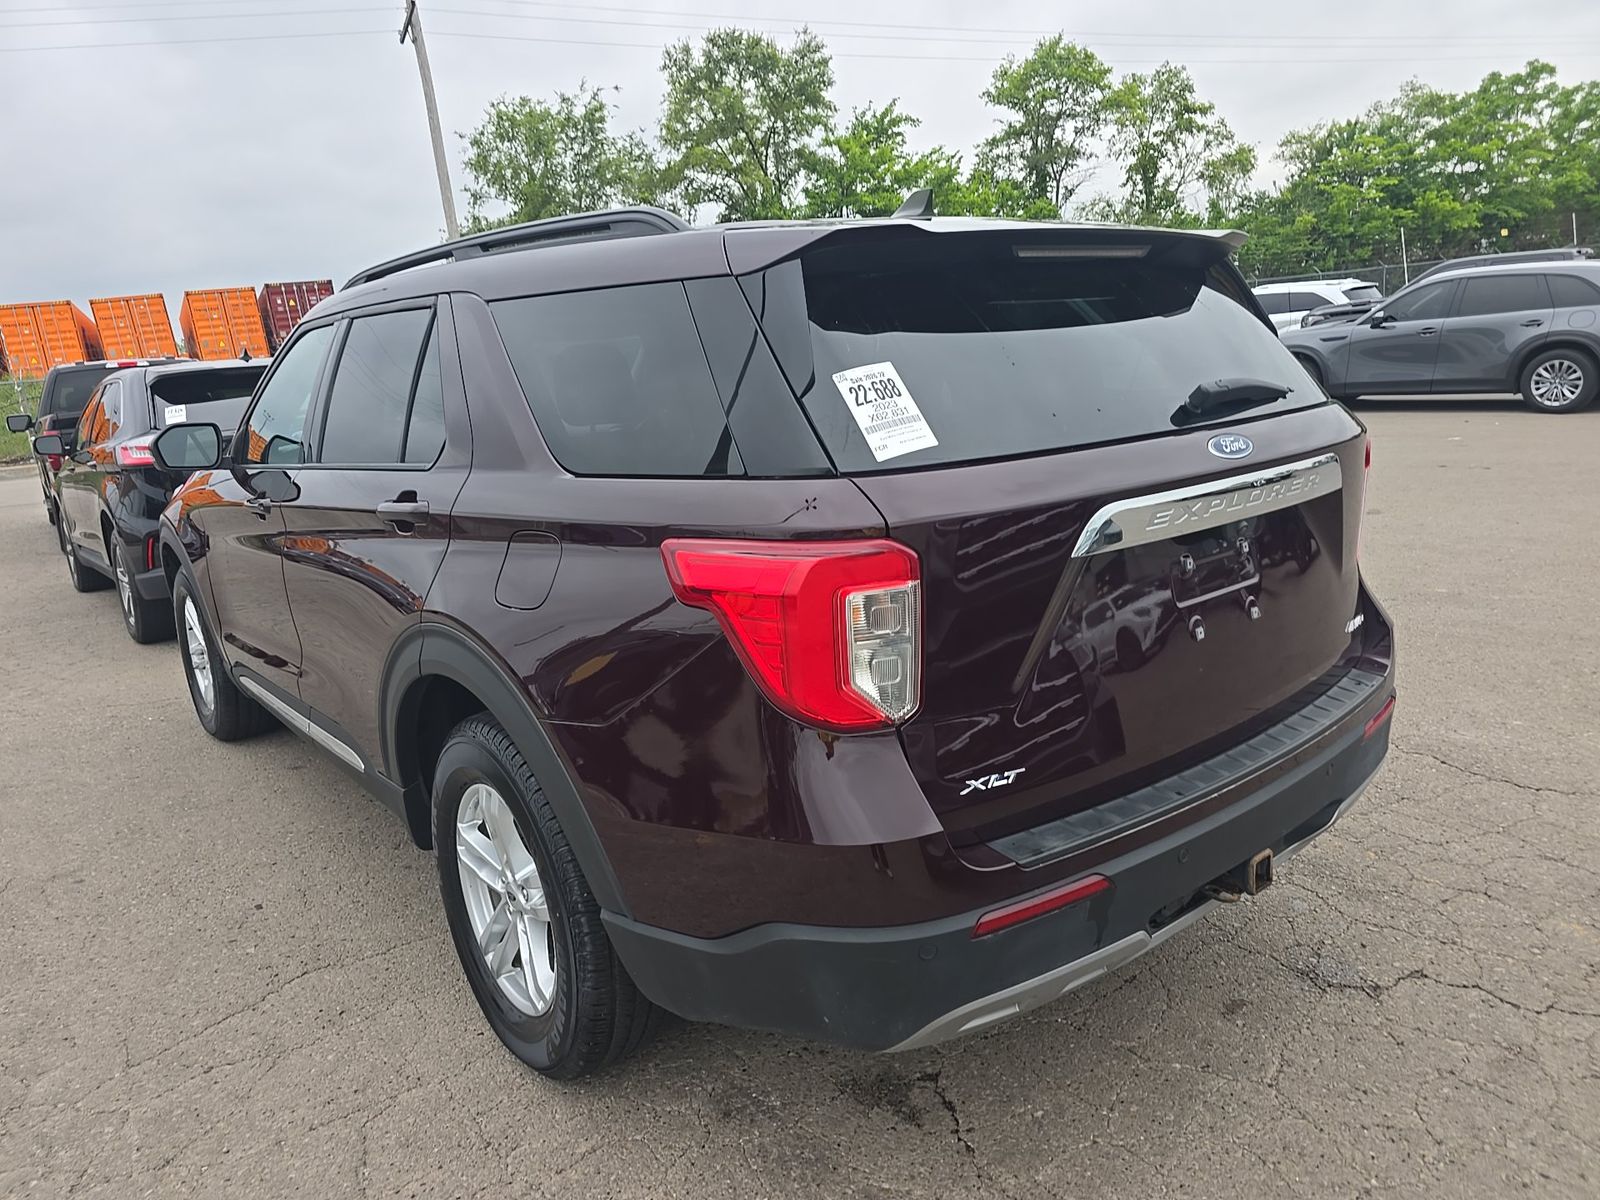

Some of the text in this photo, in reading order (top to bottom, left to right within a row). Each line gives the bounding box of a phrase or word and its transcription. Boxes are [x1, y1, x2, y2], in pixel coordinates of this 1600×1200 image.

[849, 377, 902, 407] 22:688
[872, 399, 898, 412] 2023
[1145, 472, 1321, 531] EXPLORER
[959, 767, 1026, 796] XLT
